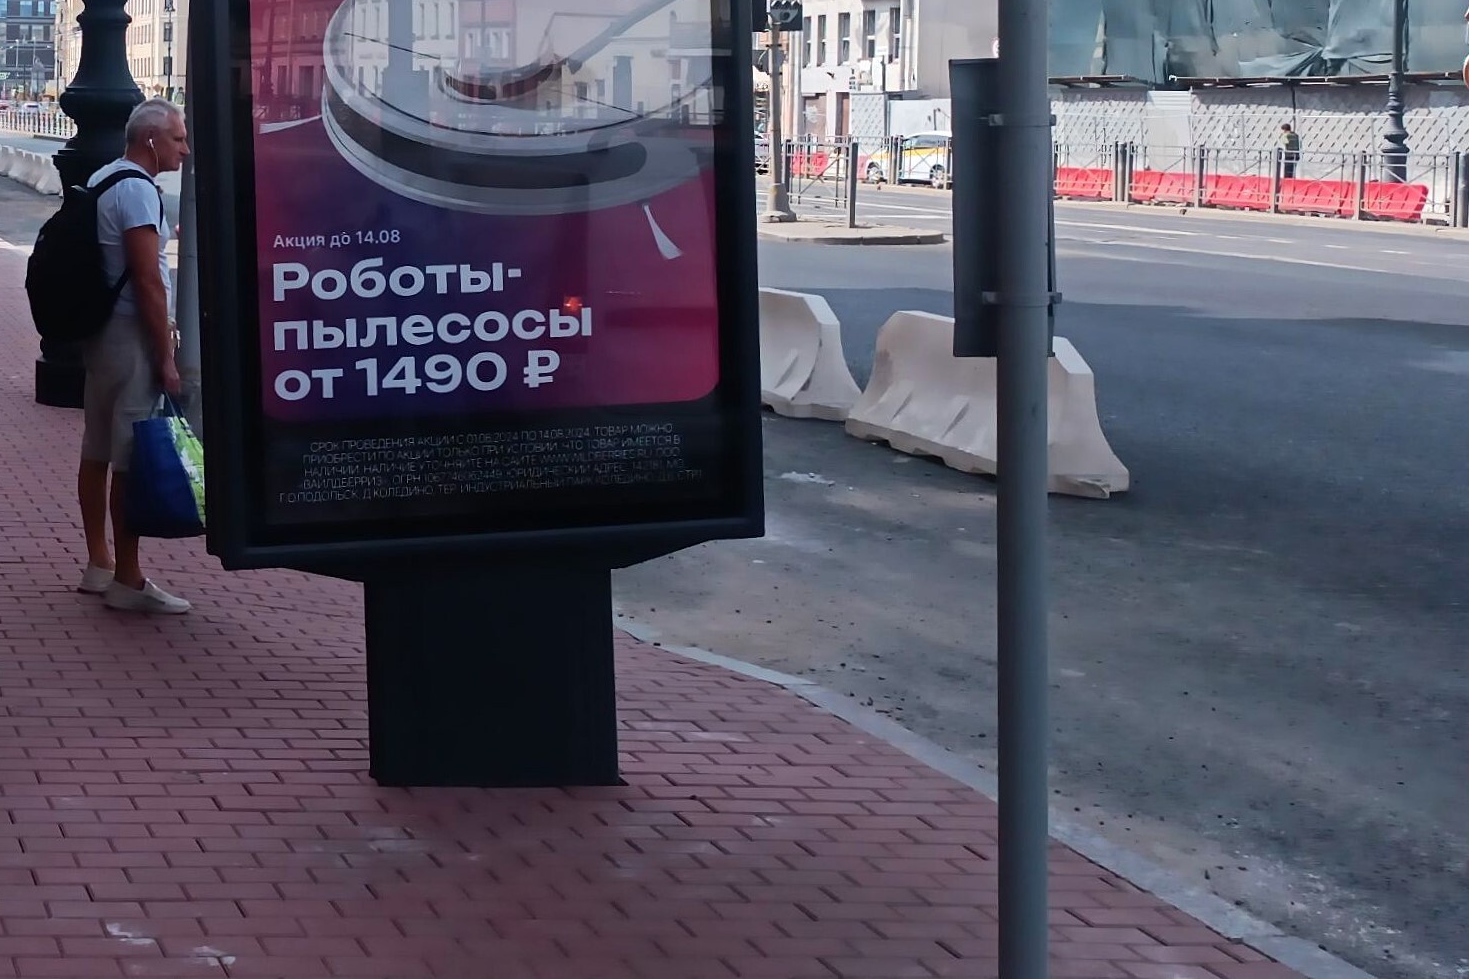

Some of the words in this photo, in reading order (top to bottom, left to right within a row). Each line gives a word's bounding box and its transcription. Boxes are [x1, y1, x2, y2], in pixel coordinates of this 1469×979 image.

[273, 234, 325, 249] Акция
[329, 232, 351, 248] до
[355, 229, 401, 244] 14.08
[273, 257, 522, 302] Роботы-
[273, 307, 592, 351] пылесосы
[274, 368, 343, 401] от
[355, 351, 508, 396] 1490
[523, 349, 560, 388] ₽
[302, 451, 376, 464] ПРИОБРЕСТИ
[377, 450, 395, 460] ПО
[586, 437, 621, 449] ТОВАР
[341, 437, 415, 451] ПРОВЕДЕНИЯ
[520, 430, 537, 441] ПО
[593, 425, 629, 437] ТОВАР
